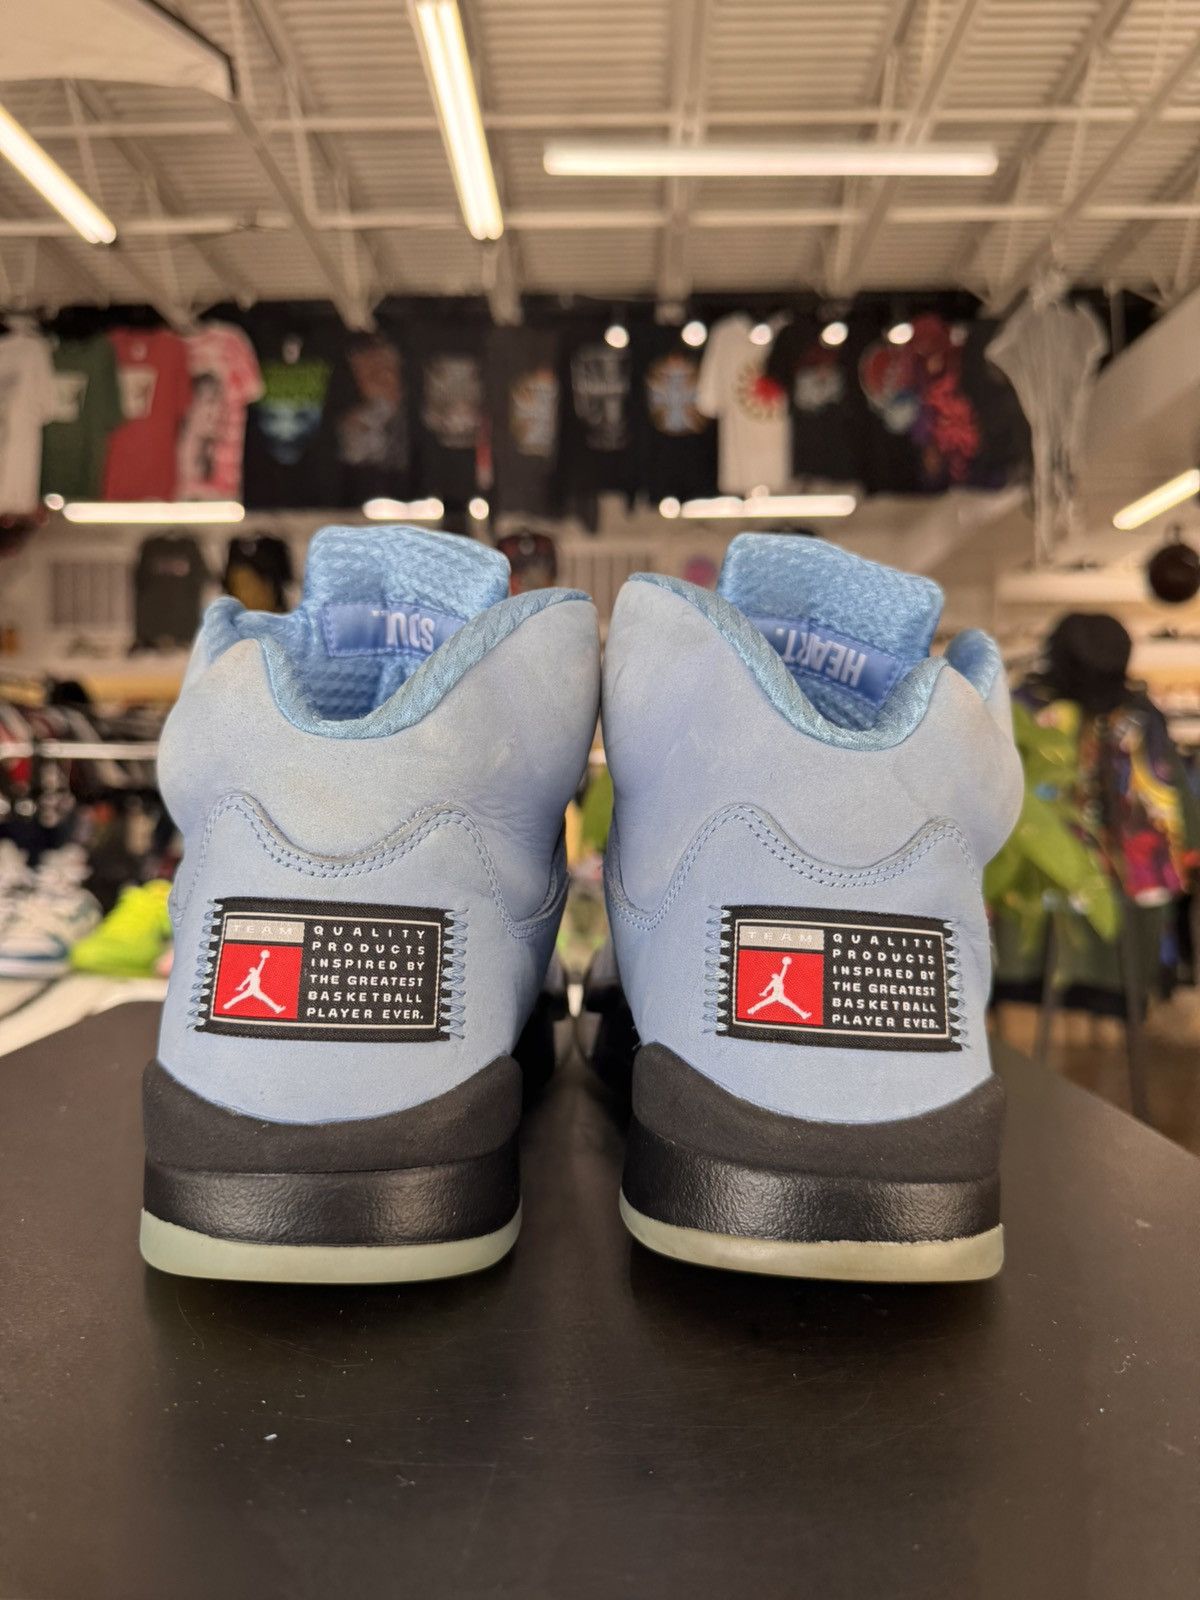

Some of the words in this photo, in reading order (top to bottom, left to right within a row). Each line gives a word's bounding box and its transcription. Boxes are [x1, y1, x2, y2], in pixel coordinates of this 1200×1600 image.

[233, 924, 294, 936] TEAM
[313, 925, 426, 940] QUALITY
[747, 931, 815, 943] TEAM
[312, 941, 426, 956] PRODUCTS
[832, 933, 934, 949] QUALITY
[311, 958, 398, 971] INSPIRED
[407, 961, 426, 972] BY
[832, 950, 935, 965] PRODUCTS
[309, 974, 340, 986] THE
[347, 976, 424, 987] GREATEST
[832, 965, 914, 980] INSPIRED
[920, 970, 936, 981] BY
[832, 981, 862, 992] THE
[868, 984, 936, 997] GREATEST
[307, 990, 423, 1004] BASKETBALL
[306, 1007, 373, 1019] PLAYER
[382, 1009, 424, 1020] EVER.
[832, 998, 937, 1014] BASKETBALL
[832, 1014, 896, 1028] PLAYER
[903, 1018, 940, 1030] EVER.
